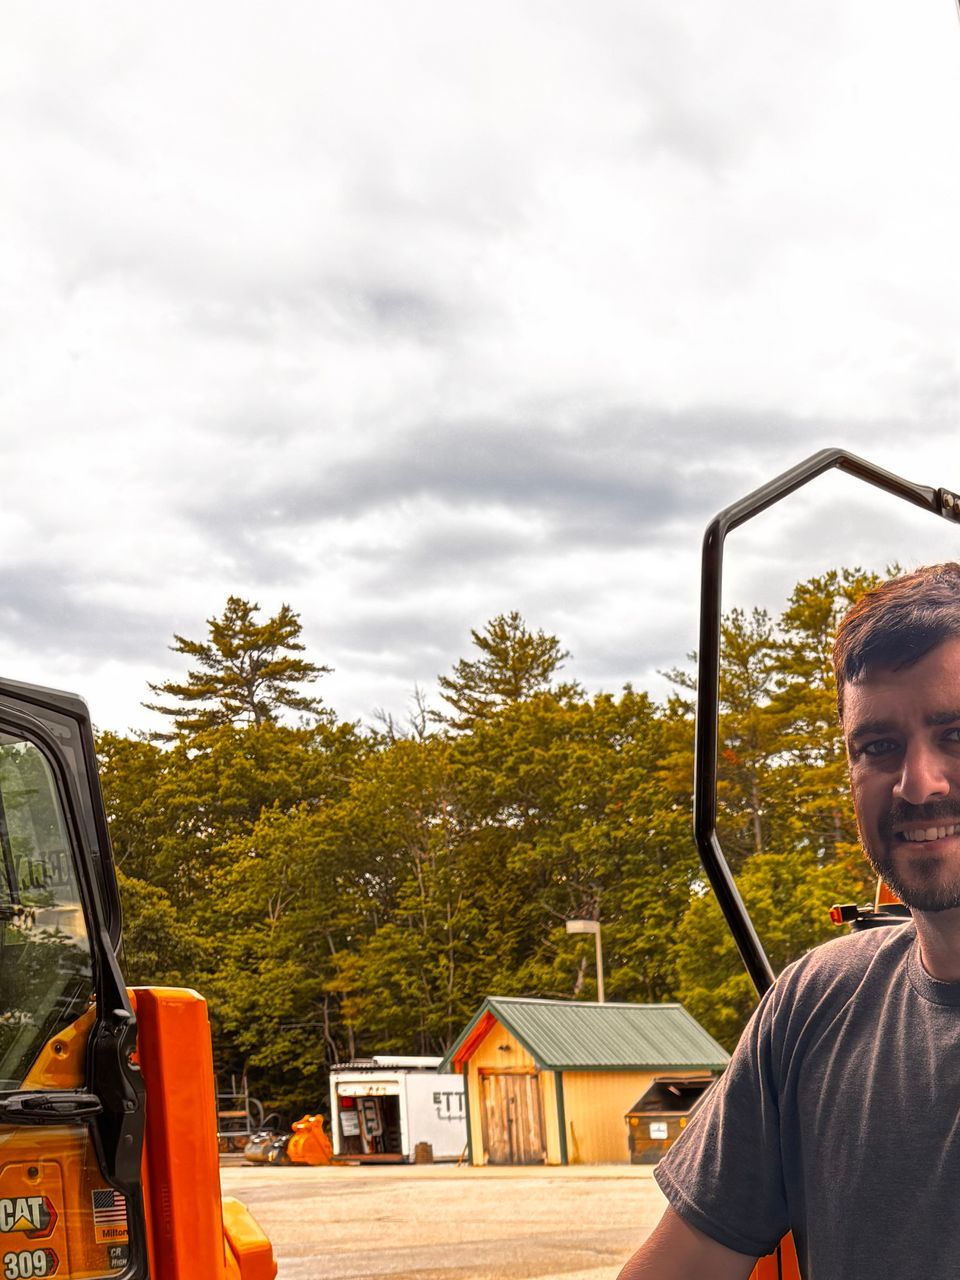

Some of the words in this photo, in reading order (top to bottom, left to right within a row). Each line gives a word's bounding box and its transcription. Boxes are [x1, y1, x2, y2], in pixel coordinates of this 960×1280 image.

[0, 1197, 42, 1232] CAT
[4, 1250, 47, 1280] 309
[111, 1247, 121, 1257] CR
